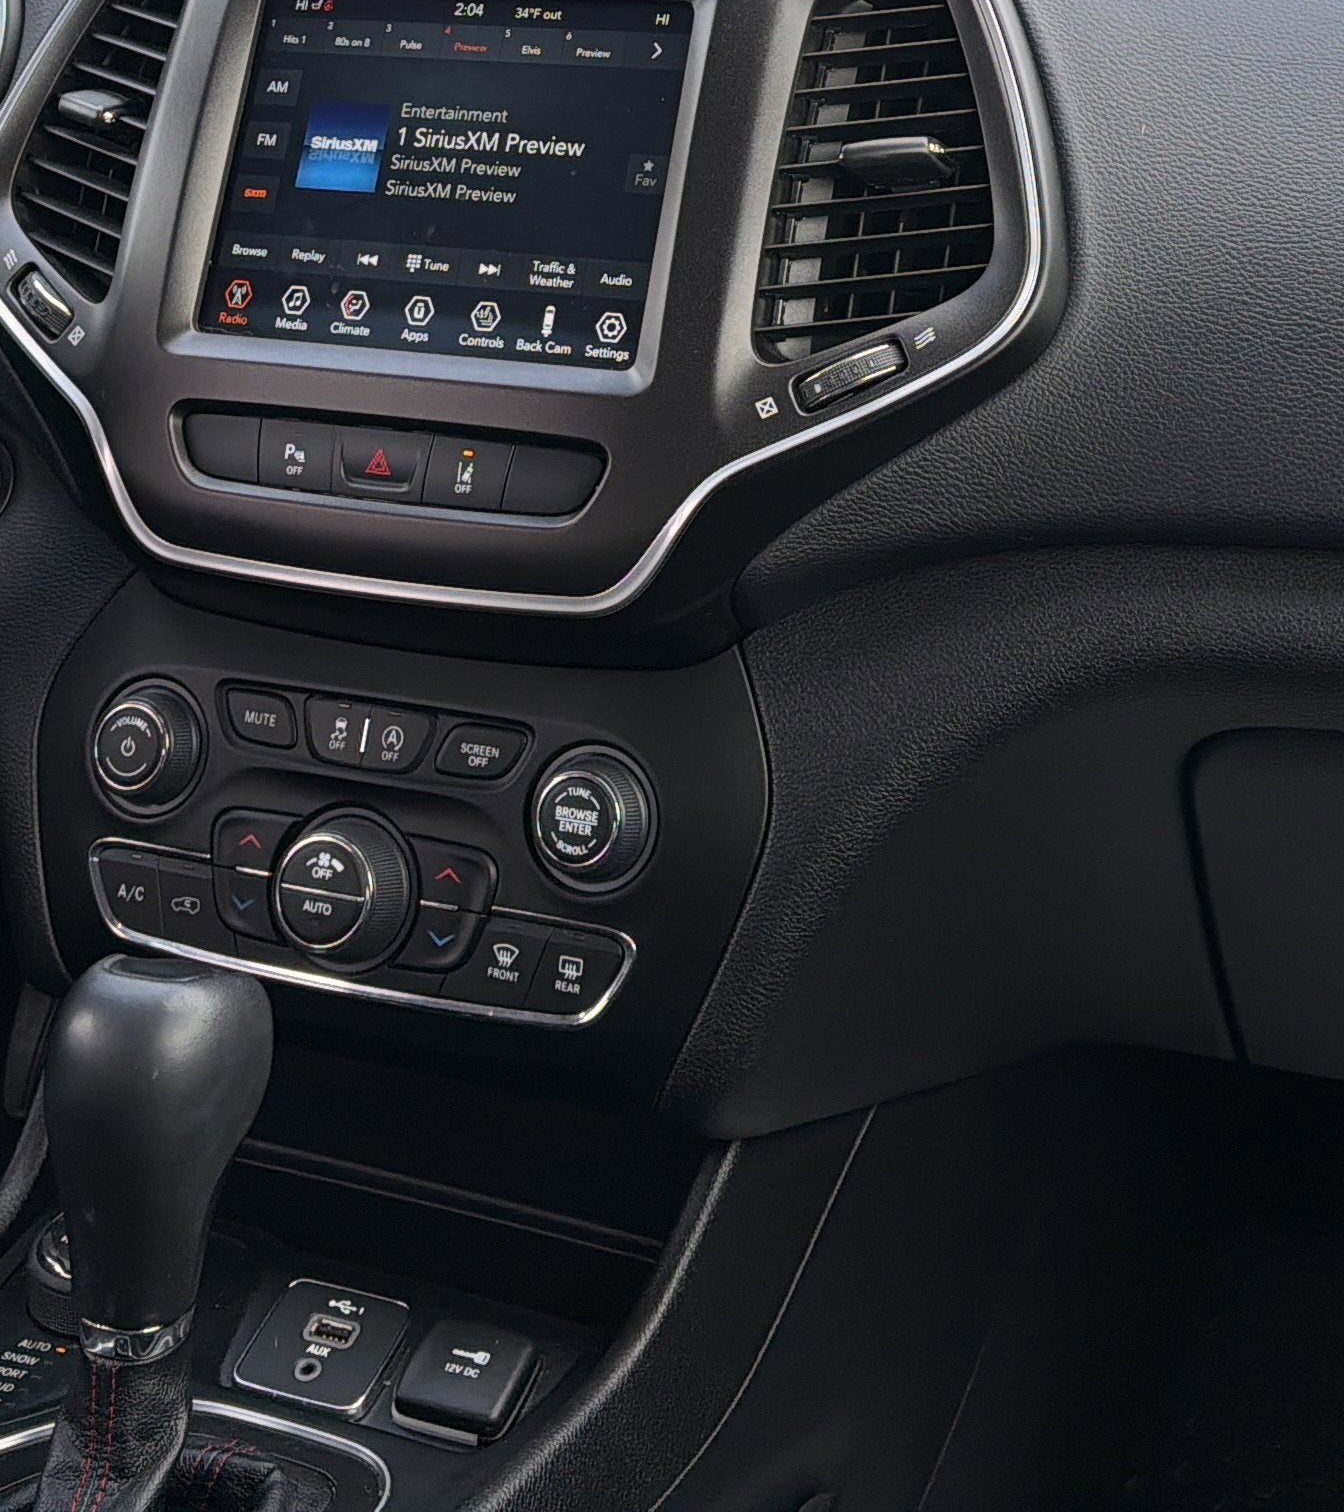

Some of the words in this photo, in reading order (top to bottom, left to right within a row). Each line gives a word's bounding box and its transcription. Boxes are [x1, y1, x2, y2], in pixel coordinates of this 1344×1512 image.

[295, 0, 308, 11] HI
[454, 2, 485, 17] 2:04
[515, 7, 541, 19] 34°F
[543, 8, 562, 21] out
[656, 13, 670, 26] HI
[282, 34, 299, 44] Hits
[334, 36, 350, 47] 80s
[351, 38, 363, 47] on
[364, 38, 371, 48] 8
[399, 40, 422, 50] Pulse
[454, 42, 488, 53] Preview
[522, 45, 542, 56] Elvis
[576, 47, 611, 59] Preview
[267, 81, 289, 93] AM
[401, 103, 509, 123] Entertainment
[257, 133, 277, 146] FM
[310, 135, 379, 153] SiriusXM
[398, 127, 406, 146] 1
[413, 128, 500, 152] SiriusXM
[505, 134, 586, 157] Preview
[390, 154, 456, 174] SiriusXM
[459, 159, 522, 178] Preview
[634, 173, 657, 187] Fav
[384, 179, 451, 199] SiriusXM
[455, 185, 517, 204] Preview
[232, 244, 268, 257] Browse
[291, 248, 325, 264] Replay
[424, 259, 449, 272] Tune
[533, 260, 565, 274] Traffic
[567, 263, 576, 275] &
[529, 274, 574, 289] Weather
[600, 273, 633, 286] Audio
[218, 312, 248, 326] Radio
[275, 317, 308, 331] Media
[330, 322, 370, 337] Climate
[401, 328, 429, 343] Apps
[458, 334, 504, 349] Controls
[515, 339, 543, 352] Back
[545, 342, 571, 355] Cam
[585, 345, 629, 362] Settings
[286, 465, 304, 476] OFF
[455, 483, 472, 494] OFF
[116, 716, 148, 731] VOLUME
[244, 710, 276, 727] MUTE
[328, 739, 346, 750] OFF
[460, 742, 499, 758] SCREEN
[381, 750, 399, 762] OFF
[468, 755, 488, 767] OFF
[567, 787, 591, 800] TUNE
[556, 805, 598, 821] BROWSE
[559, 821, 592, 836] ENTER
[556, 840, 589, 855] SCROLL
[311, 867, 333, 880] OFF
[117, 883, 144, 902] A/C
[302, 899, 332, 916] AUTO
[487, 966, 519, 982] FRONT
[555, 979, 581, 994] REAR
[17, 1338, 52, 1352] AUTO
[306, 1343, 332, 1358] AUX
[0, 1351, 40, 1366] SNOW
[445, 1362, 464, 1375] 12V
[463, 1367, 480, 1379] DC
